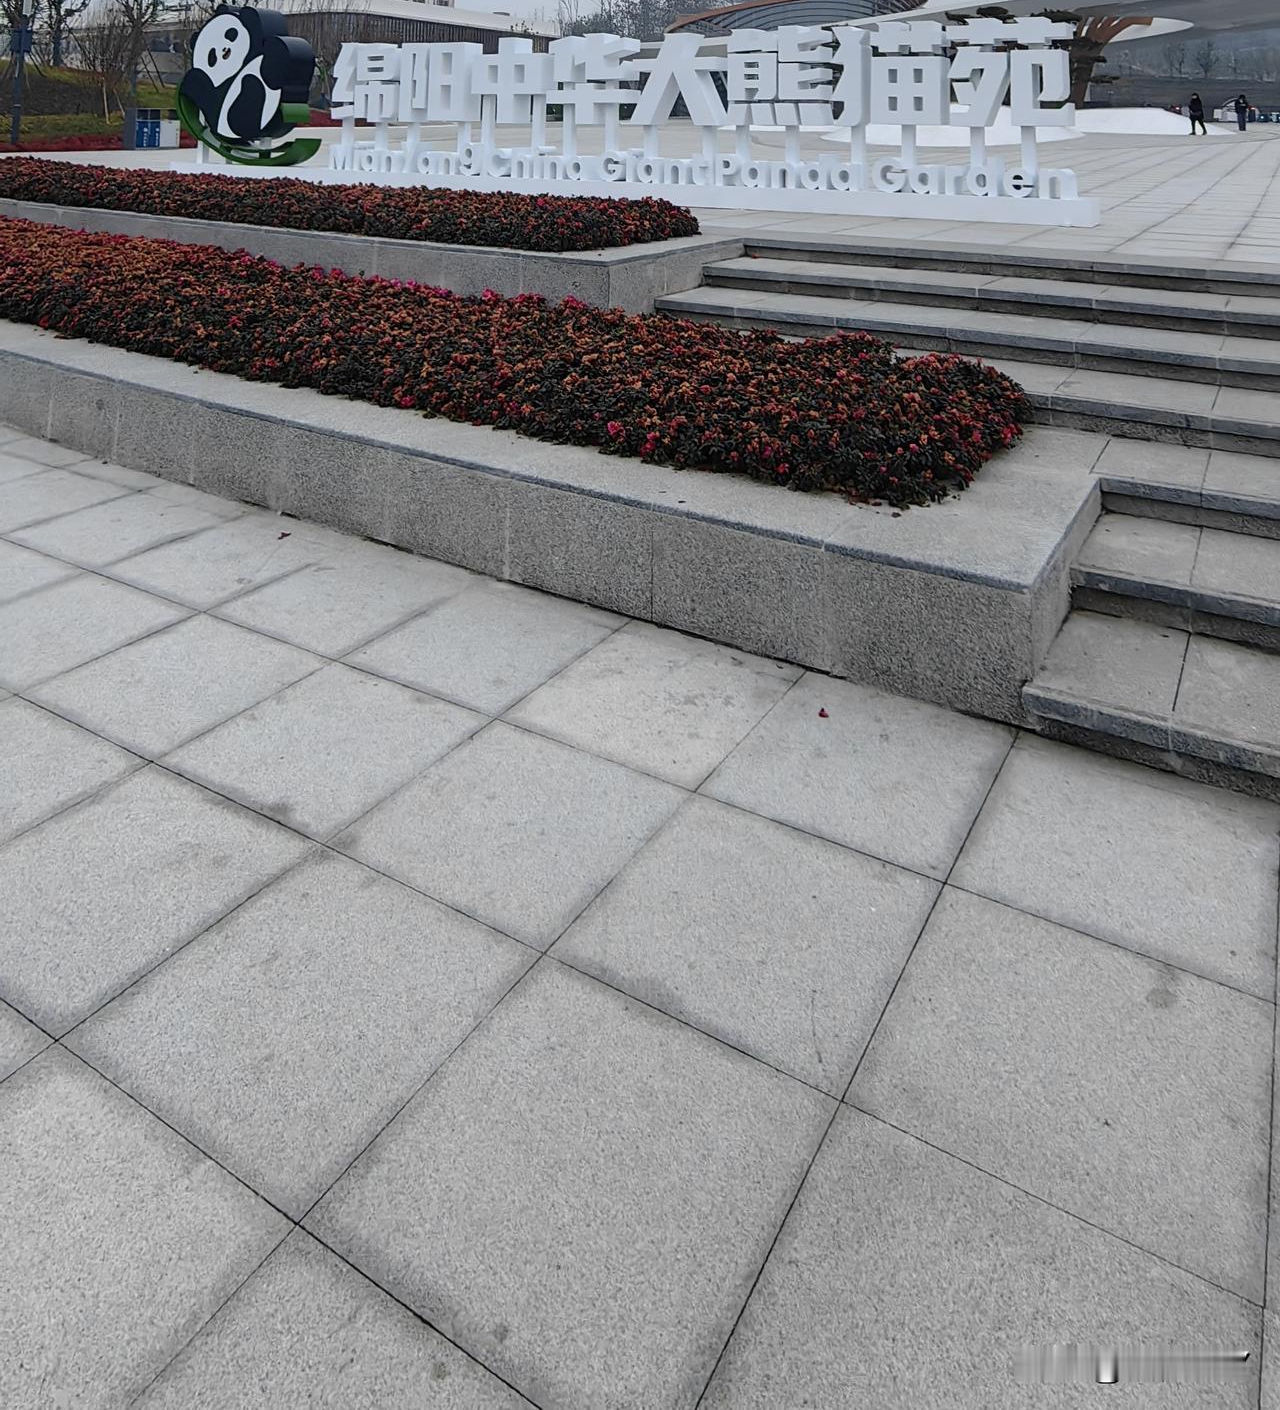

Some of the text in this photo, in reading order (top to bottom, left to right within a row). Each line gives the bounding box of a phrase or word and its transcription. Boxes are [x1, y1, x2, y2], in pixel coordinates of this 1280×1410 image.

[331, 17, 1076, 127] 绵阳中华大熊猫苑
[487, 146, 585, 181] China
[602, 148, 714, 186] Giant
[715, 153, 864, 191] Panda
[871, 156, 1078, 200] Garden
